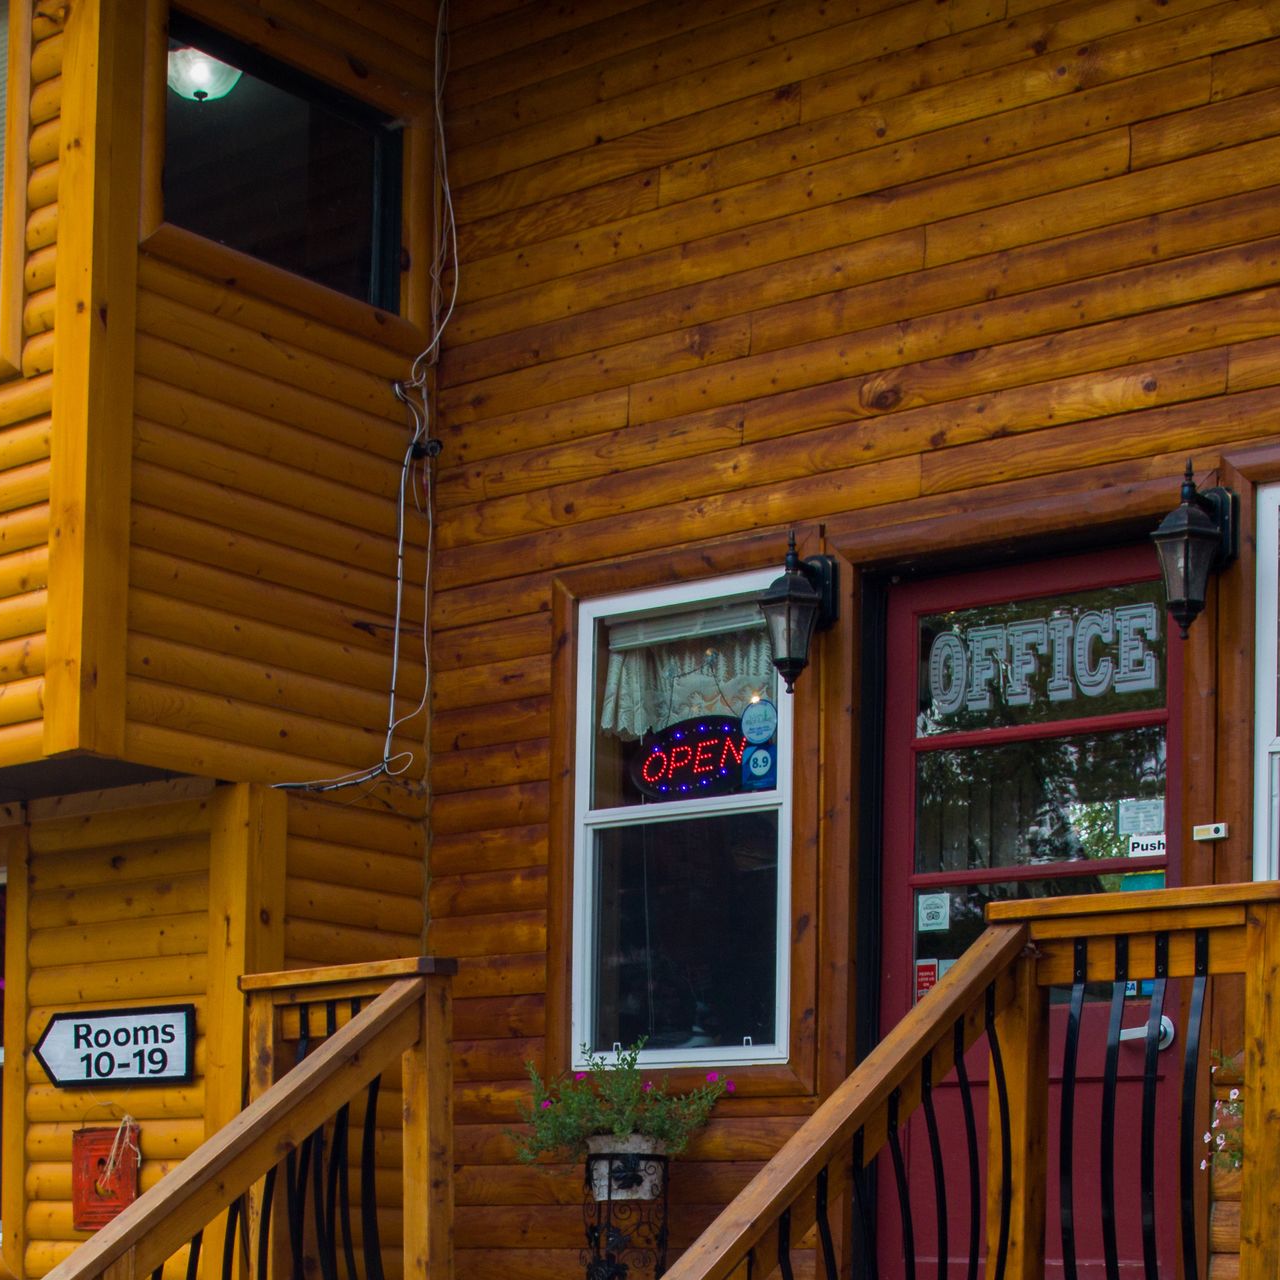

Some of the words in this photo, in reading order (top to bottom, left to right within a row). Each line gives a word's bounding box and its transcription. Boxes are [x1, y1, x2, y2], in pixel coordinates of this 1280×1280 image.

[929, 602, 1160, 714] OFFICE
[642, 736, 746, 782] OPEN
[752, 756, 769, 769] 8.9
[1131, 840, 1166, 852] Push
[73, 1023, 176, 1049] Rooms
[80, 1047, 168, 1078] 10-19
